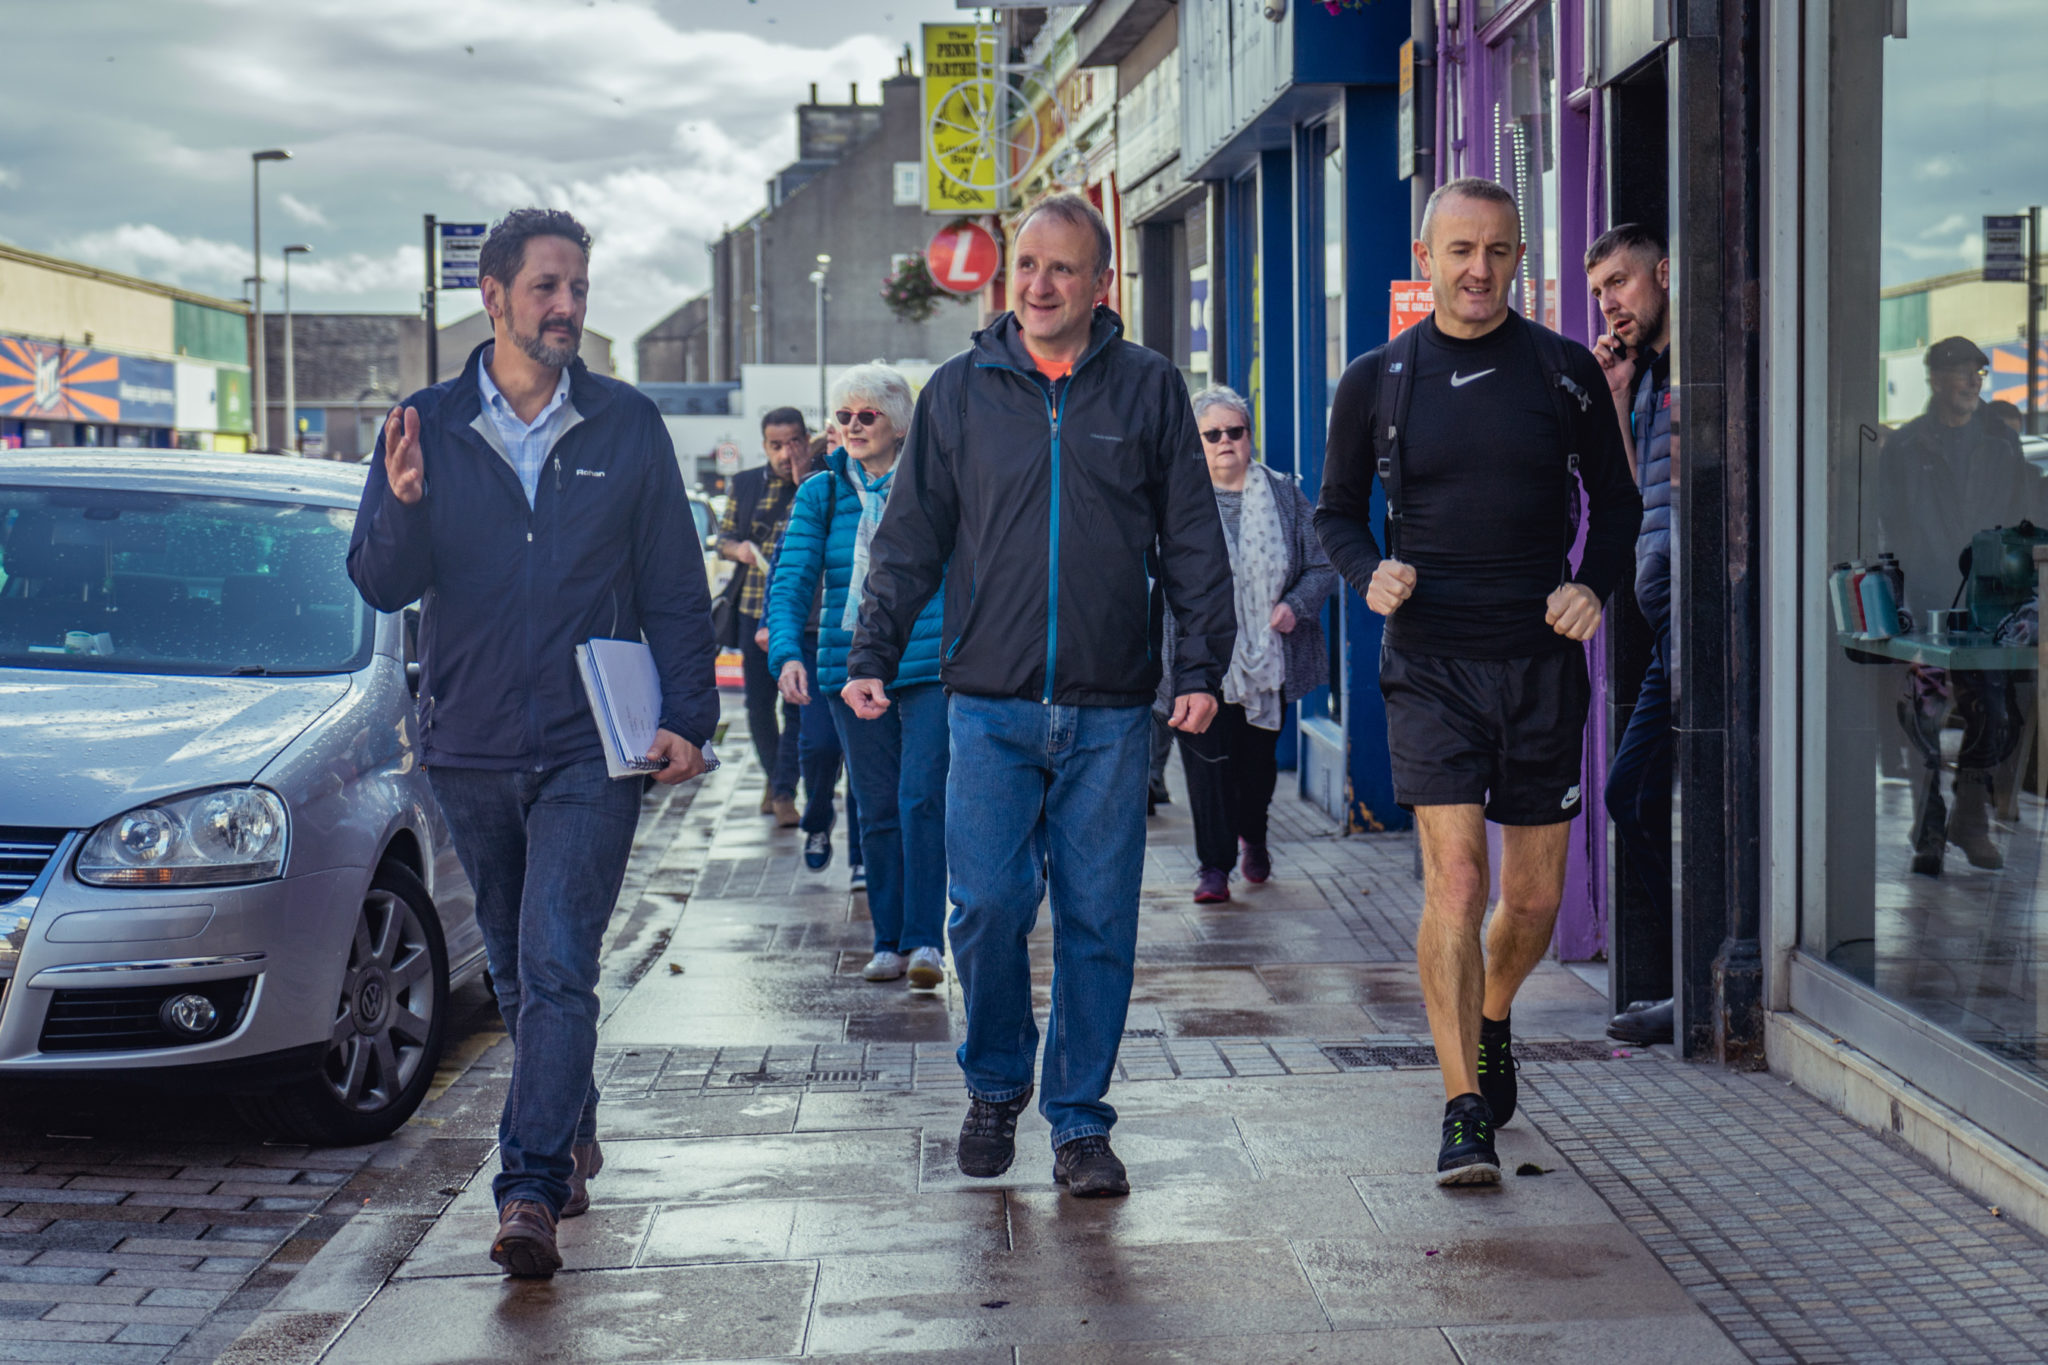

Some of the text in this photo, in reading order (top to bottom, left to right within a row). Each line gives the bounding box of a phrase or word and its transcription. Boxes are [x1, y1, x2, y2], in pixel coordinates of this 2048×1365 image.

[948, 31, 968, 39] The
[948, 230, 980, 282] L
[1396, 302, 1410, 312] THE
